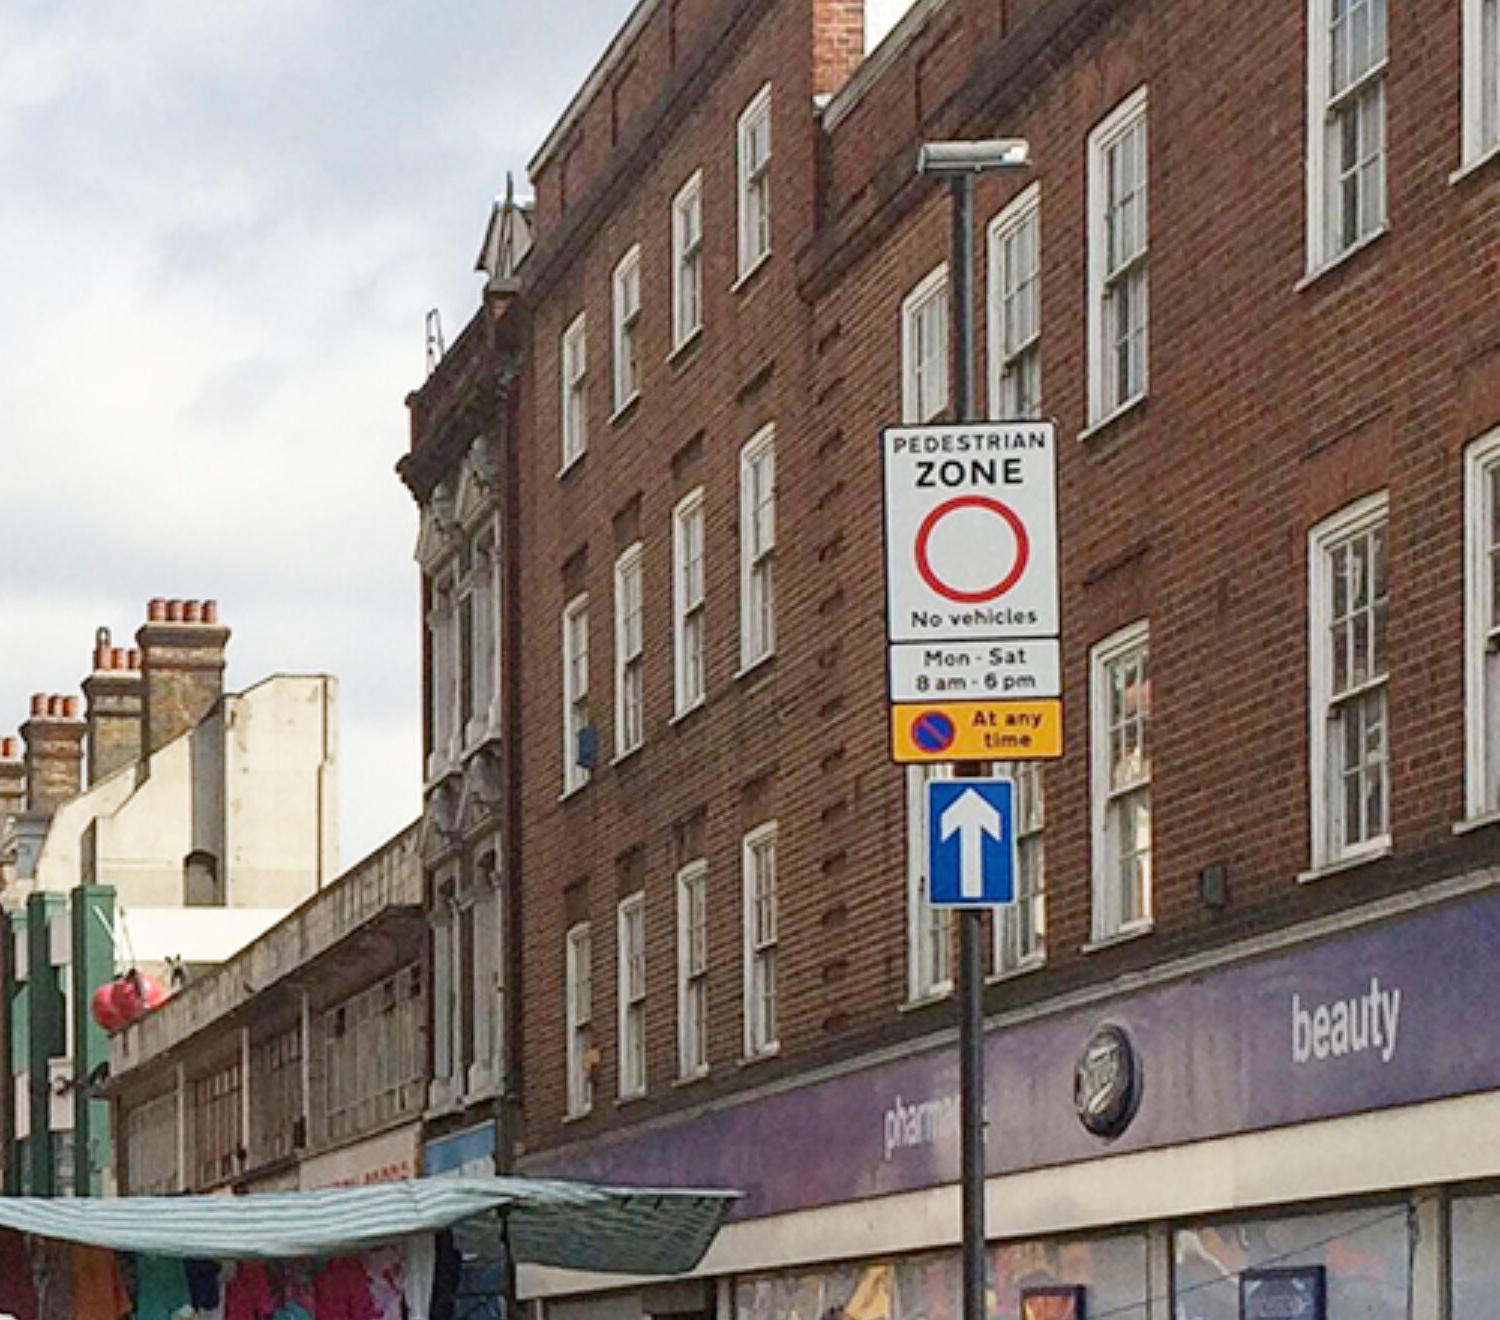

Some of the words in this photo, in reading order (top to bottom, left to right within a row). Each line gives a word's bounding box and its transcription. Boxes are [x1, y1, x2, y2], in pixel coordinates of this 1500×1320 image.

[893, 432, 1045, 454] PEDESTRIAN
[915, 457, 1024, 488] ZONE
[911, 610, 942, 628] No
[948, 608, 1038, 626] vehicles
[923, 649, 971, 667] Mon
[988, 646, 1027, 666] Sat
[971, 709, 997, 727] At
[1005, 712, 1042, 729] any
[984, 731, 1033, 748] time
[1292, 977, 1401, 1063] beauty
